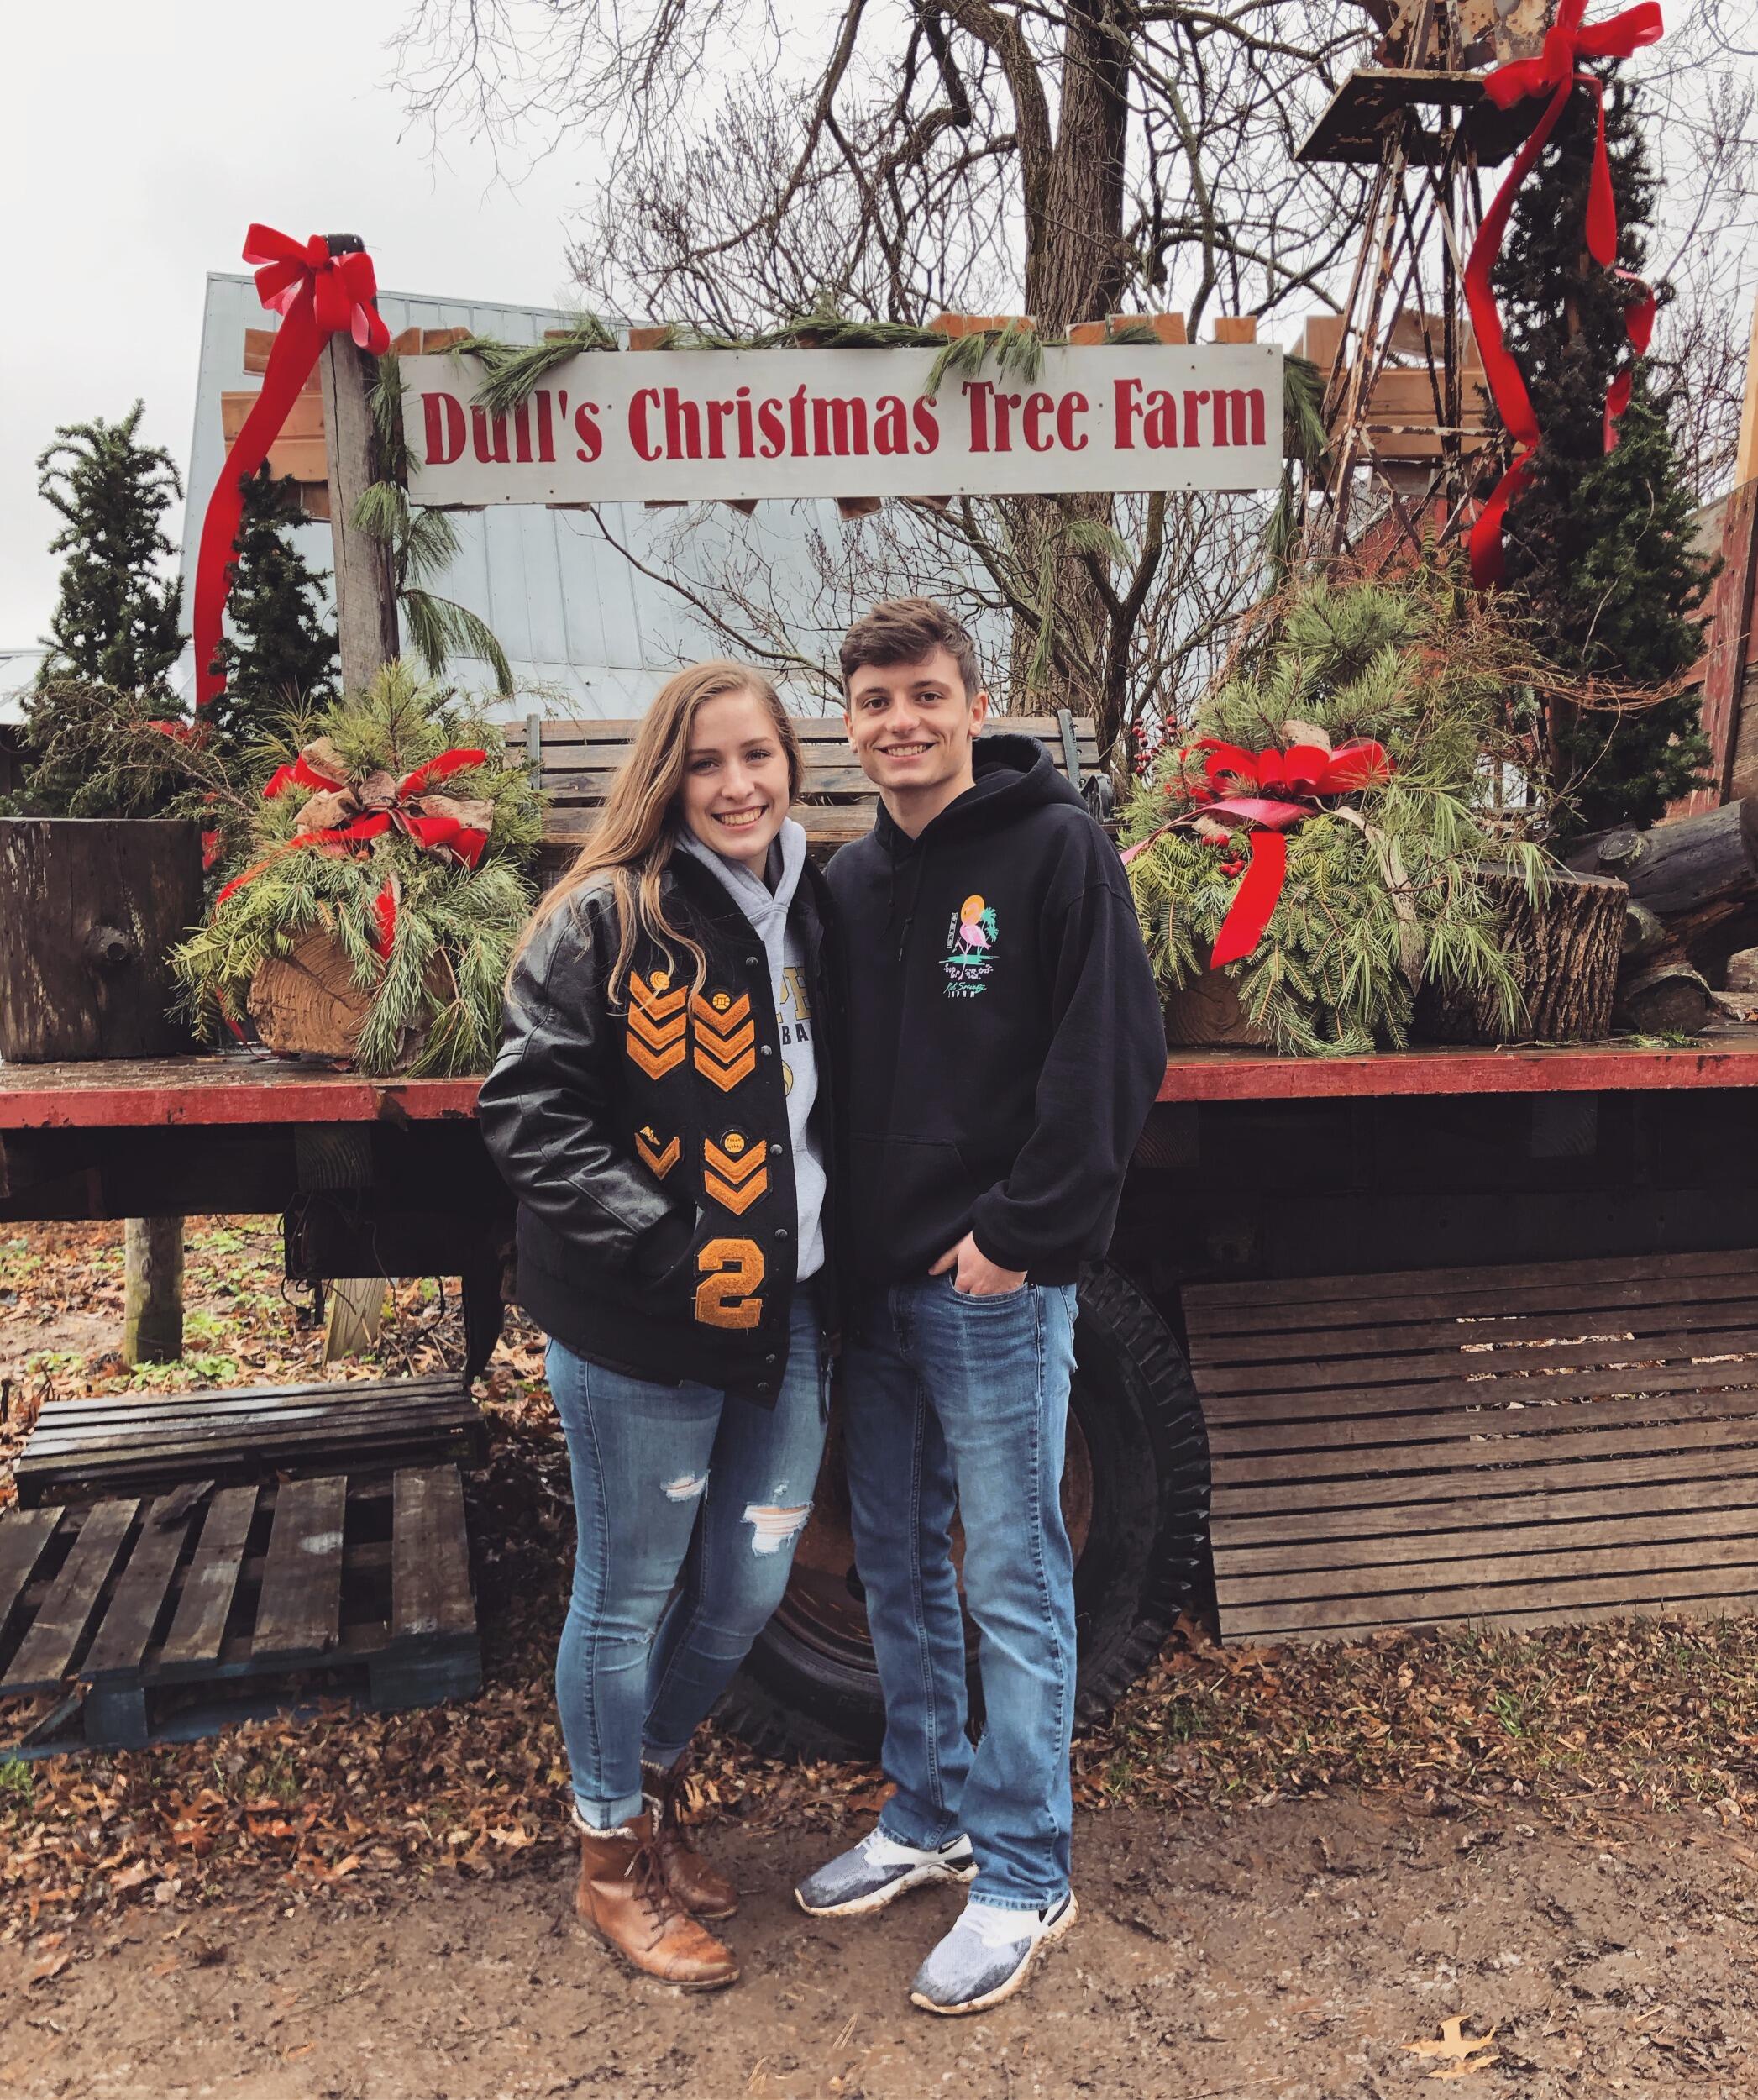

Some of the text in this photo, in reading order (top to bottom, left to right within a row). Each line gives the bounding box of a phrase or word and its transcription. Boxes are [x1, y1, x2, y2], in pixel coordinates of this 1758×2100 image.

[421, 378, 1266, 465] Dull's Christmas Tree Farm
[782, 1023, 811, 1045] BA
[695, 1238, 764, 1329] 2
